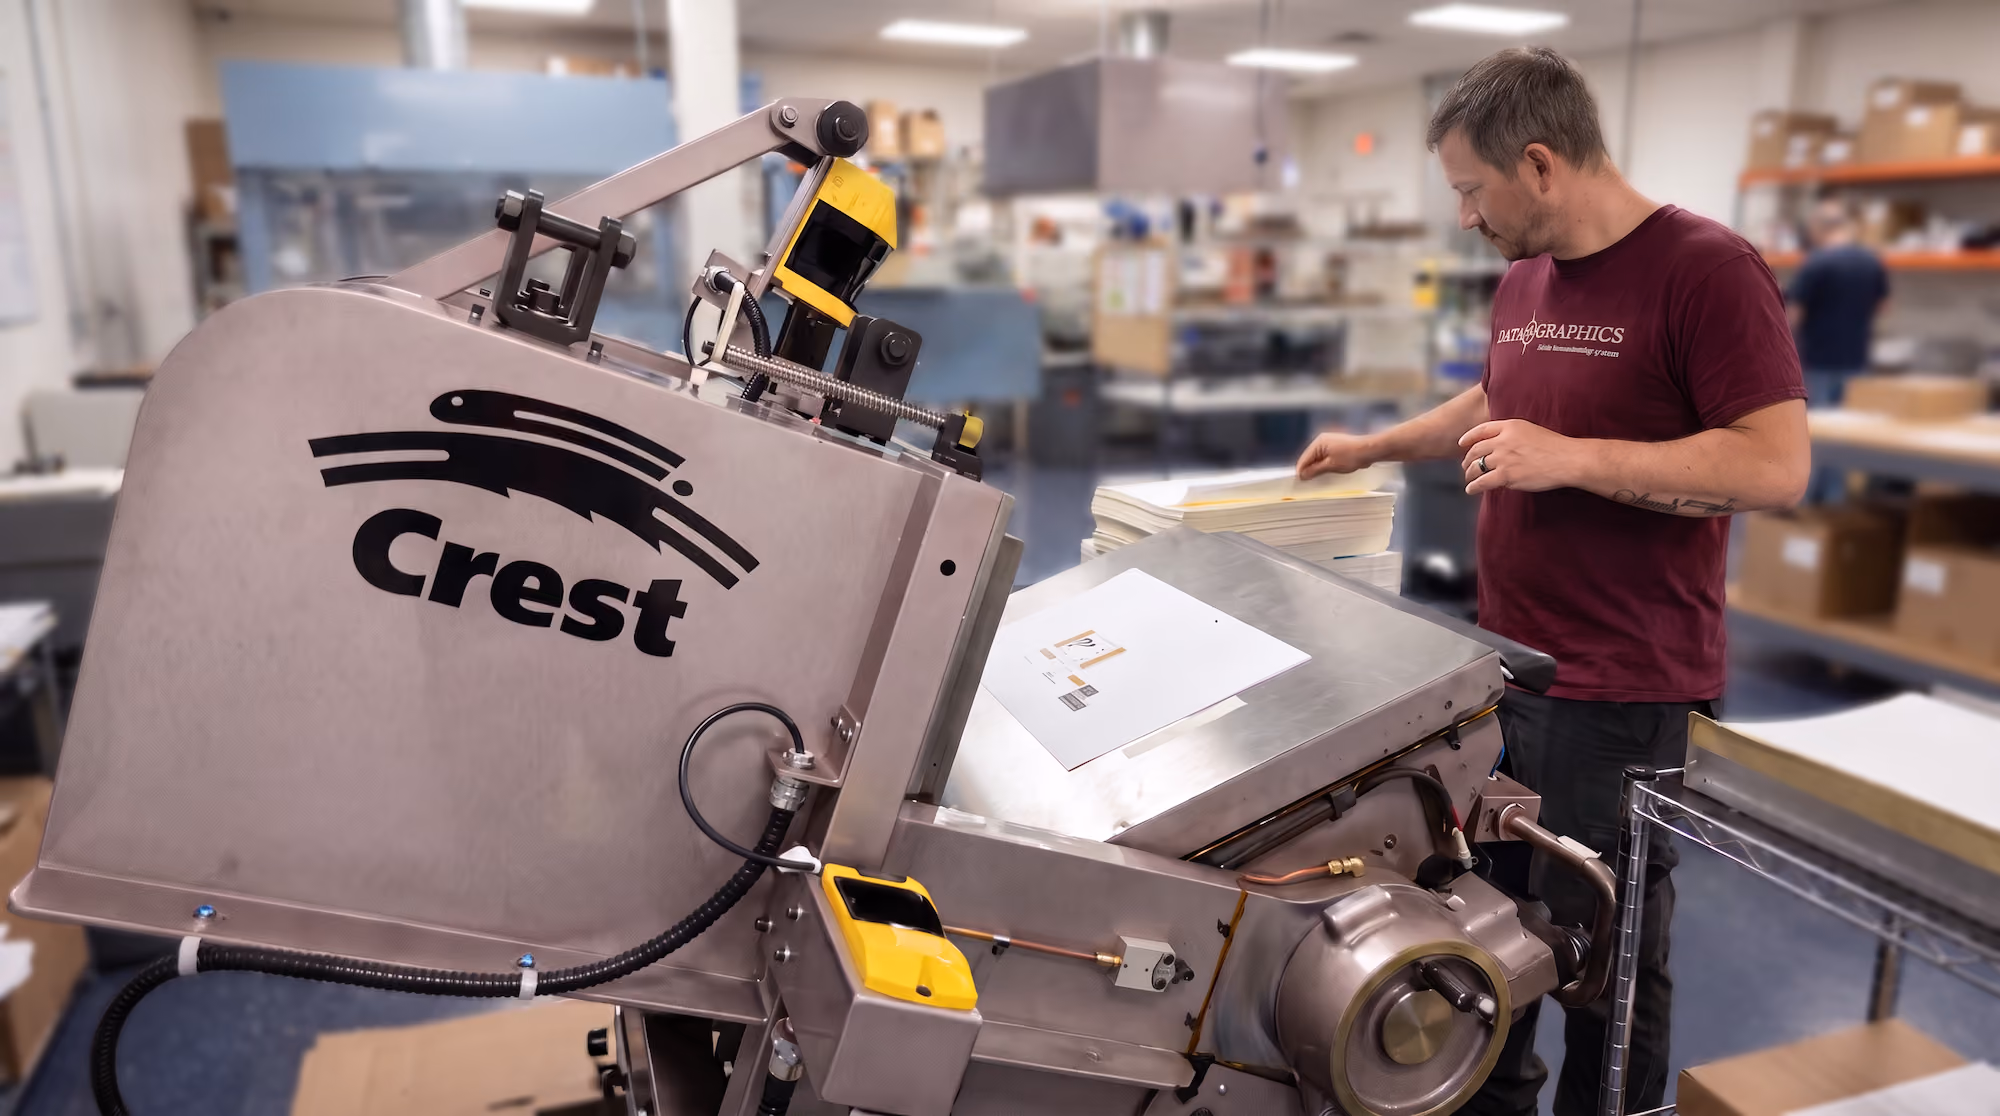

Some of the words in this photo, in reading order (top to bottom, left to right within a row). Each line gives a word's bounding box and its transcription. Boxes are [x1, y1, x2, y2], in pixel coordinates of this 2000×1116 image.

[1497, 328, 1524, 344] DATA
[1536, 323, 1625, 344] GRAPHICS
[352, 508, 688, 657] Crest
